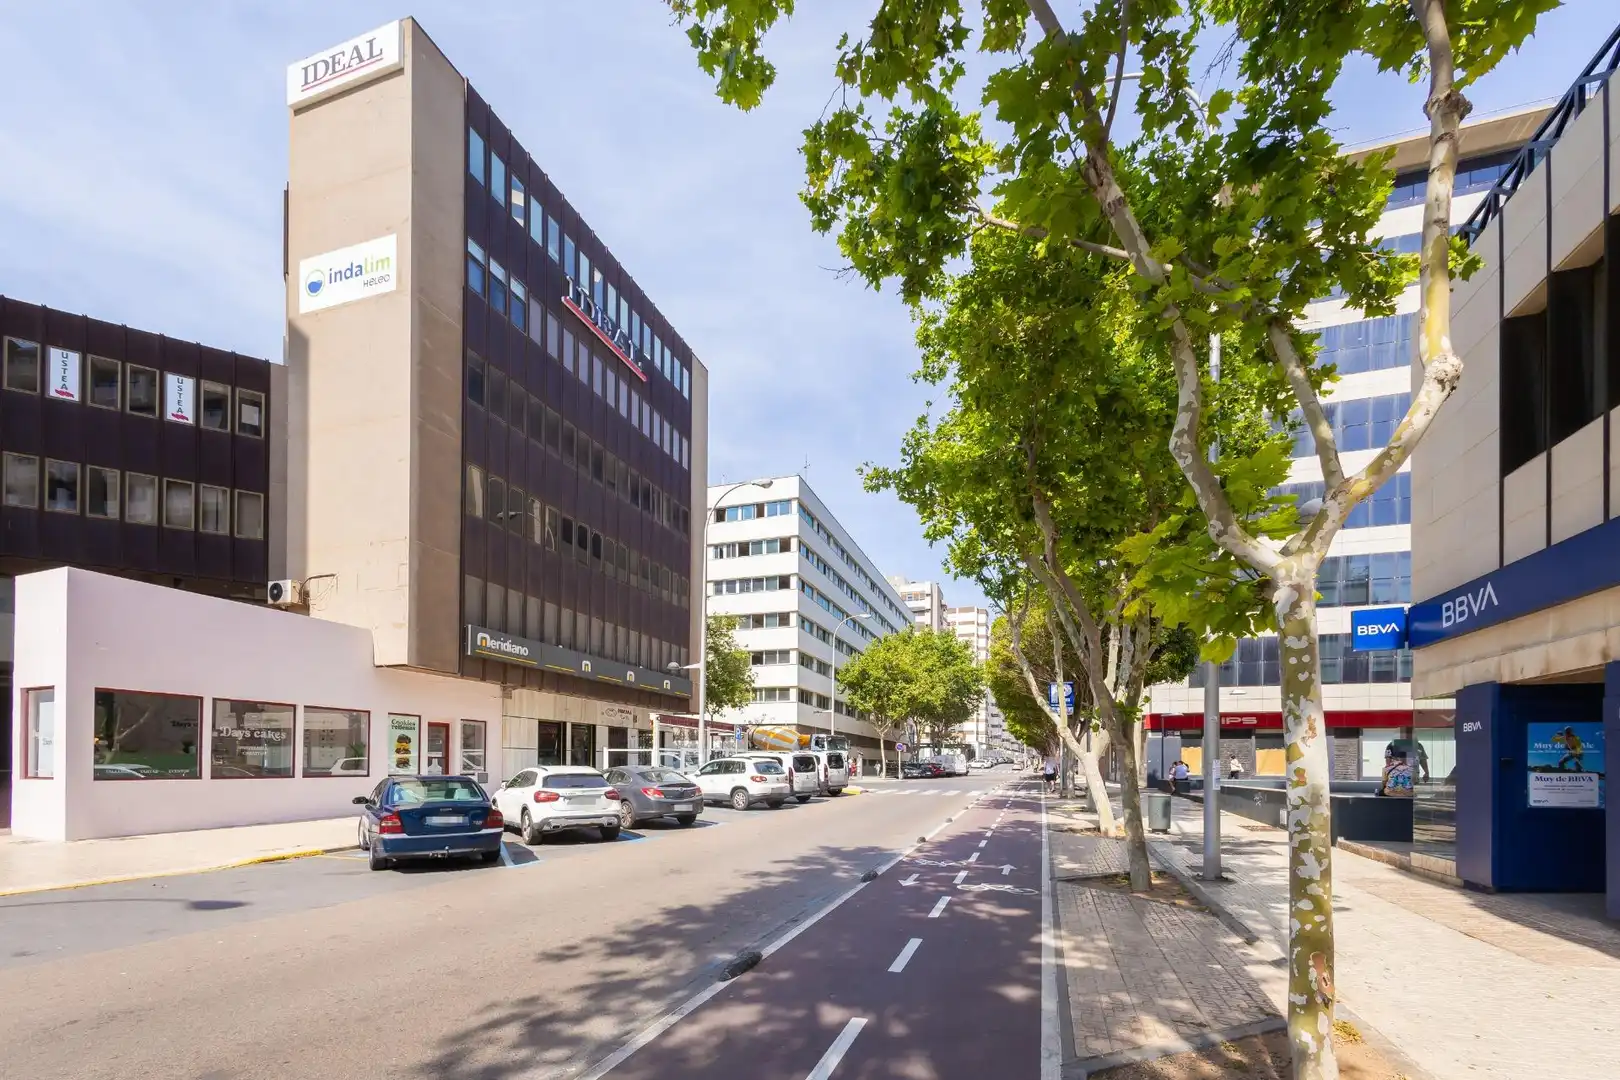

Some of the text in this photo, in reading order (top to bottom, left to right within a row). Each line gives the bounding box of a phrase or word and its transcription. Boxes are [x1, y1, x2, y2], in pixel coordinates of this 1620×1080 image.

[301, 37, 383, 87] IDEAL
[328, 253, 391, 284] indalim
[60, 351, 69, 390] USTEA
[176, 377, 184, 413] USTEA
[1442, 581, 1499, 629] BBVA
[1357, 622, 1400, 636] BBVA
[1221, 716, 1258, 725] IPS
[1463, 720, 1482, 732] BBVA
[253, 729, 287, 741] cakes
[1533, 742, 1554, 750] Muy
[1534, 775, 1554, 783] Muy
[1568, 775, 1594, 783] BBVA
